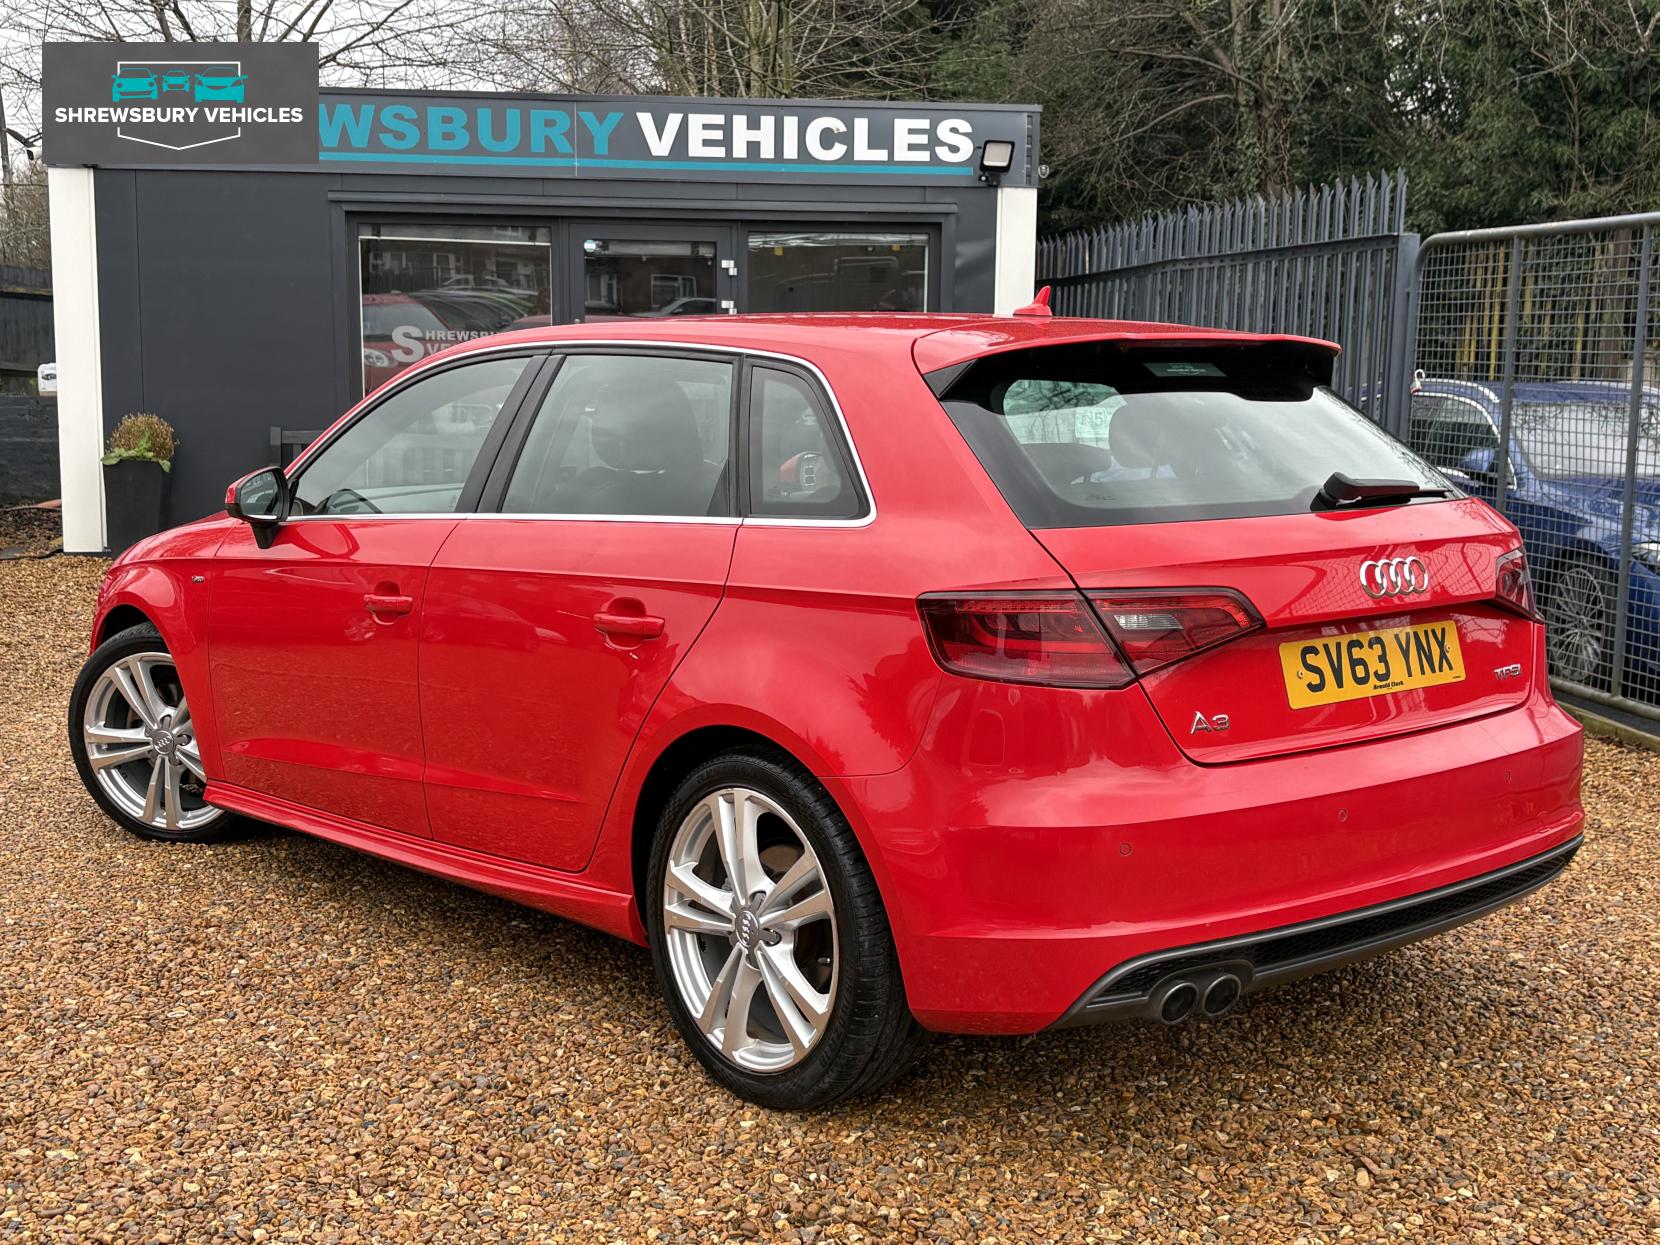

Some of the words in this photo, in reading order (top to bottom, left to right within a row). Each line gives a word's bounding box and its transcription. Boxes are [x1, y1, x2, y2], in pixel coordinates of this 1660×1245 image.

[635, 111, 974, 163] VEHICLES
[391, 325, 498, 363] SHREWSB
[1300, 635, 1391, 693] SV63
[1394, 627, 1454, 678] YNX
[1190, 710, 1230, 735] A3
